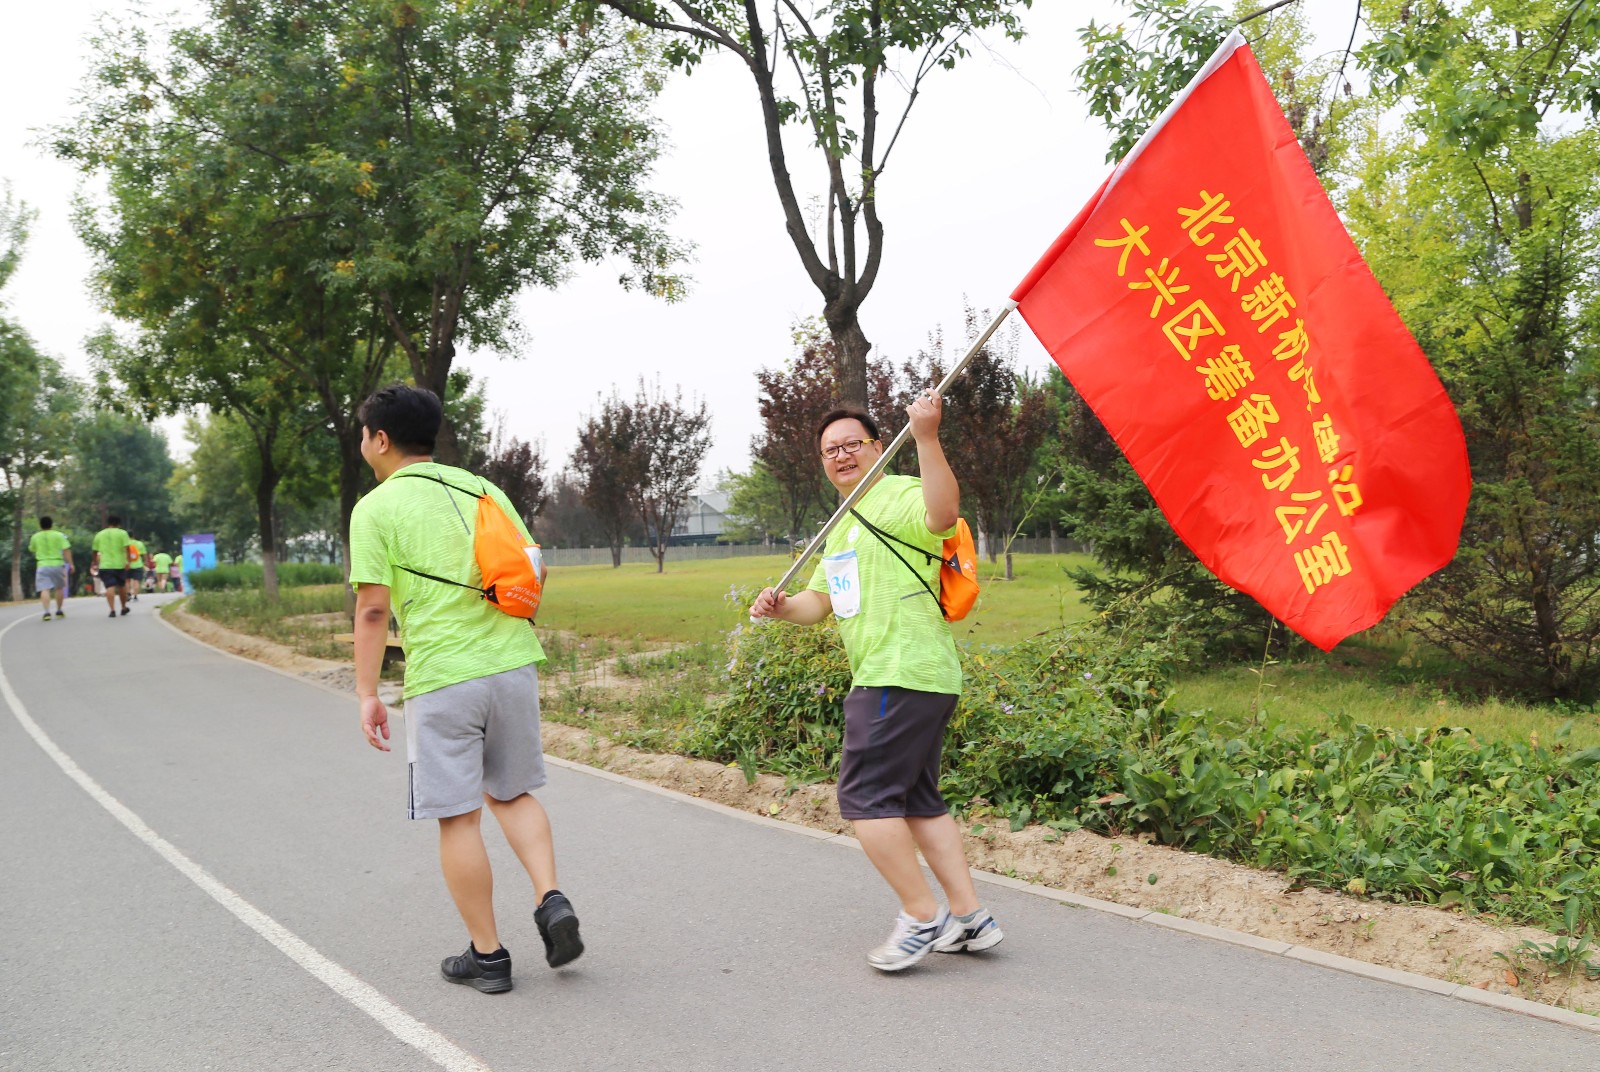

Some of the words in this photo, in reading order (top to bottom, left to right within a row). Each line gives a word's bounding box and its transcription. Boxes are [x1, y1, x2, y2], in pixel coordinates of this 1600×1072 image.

[1094, 217, 1353, 594] 大兴区筹备办公室
